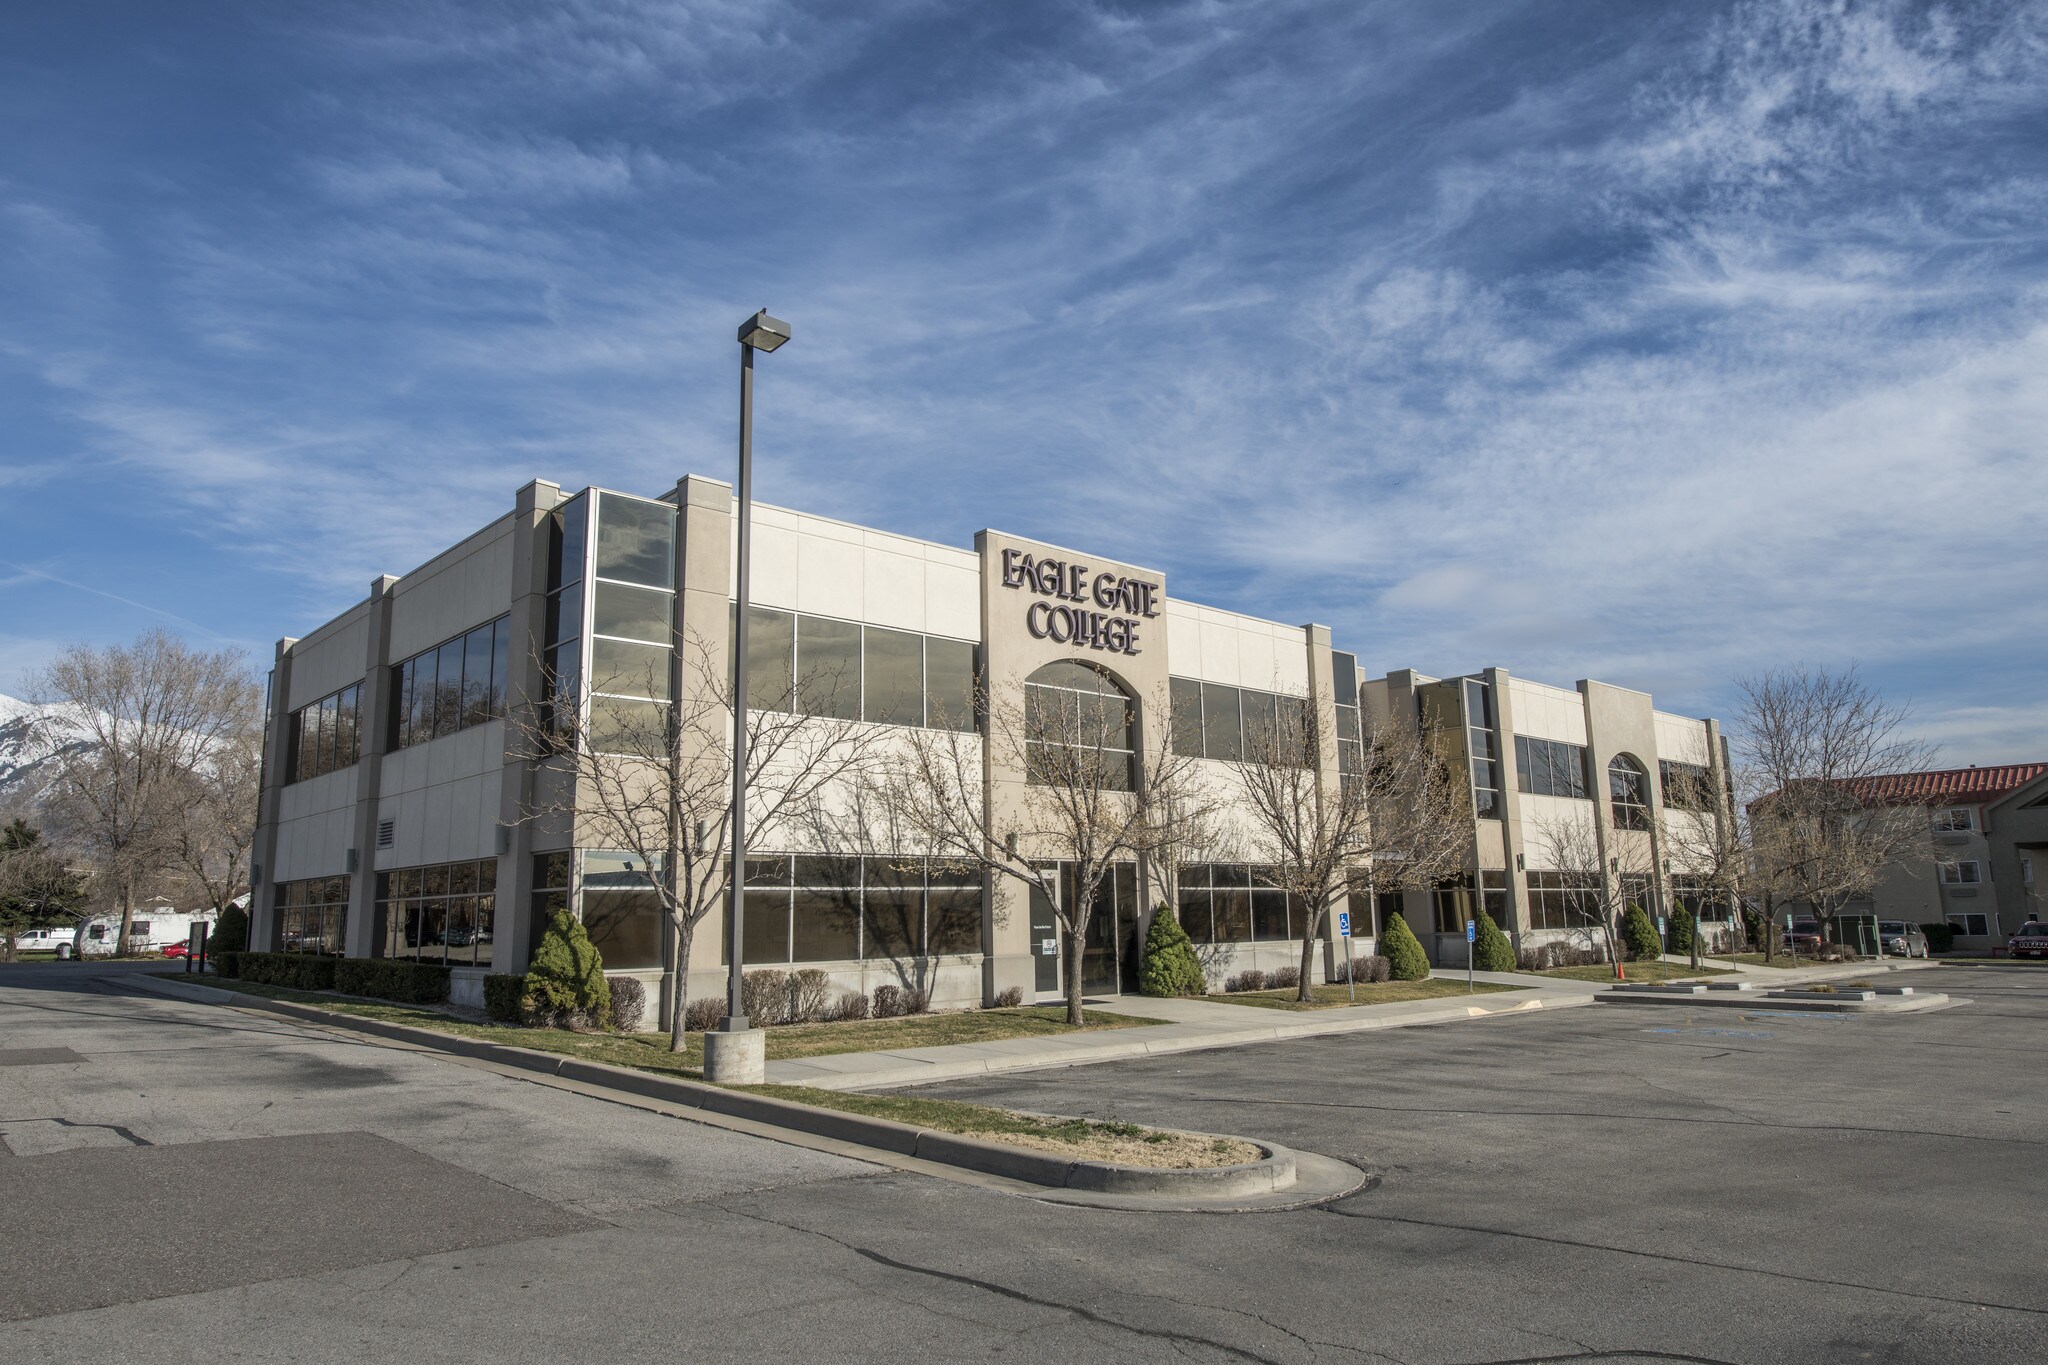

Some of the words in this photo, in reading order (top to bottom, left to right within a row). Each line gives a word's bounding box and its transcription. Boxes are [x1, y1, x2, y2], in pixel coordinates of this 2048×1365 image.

[1002, 548, 1089, 602] EAGLE
[1093, 573, 1160, 619] GATE
[1027, 601, 1142, 656] COLLEGE
